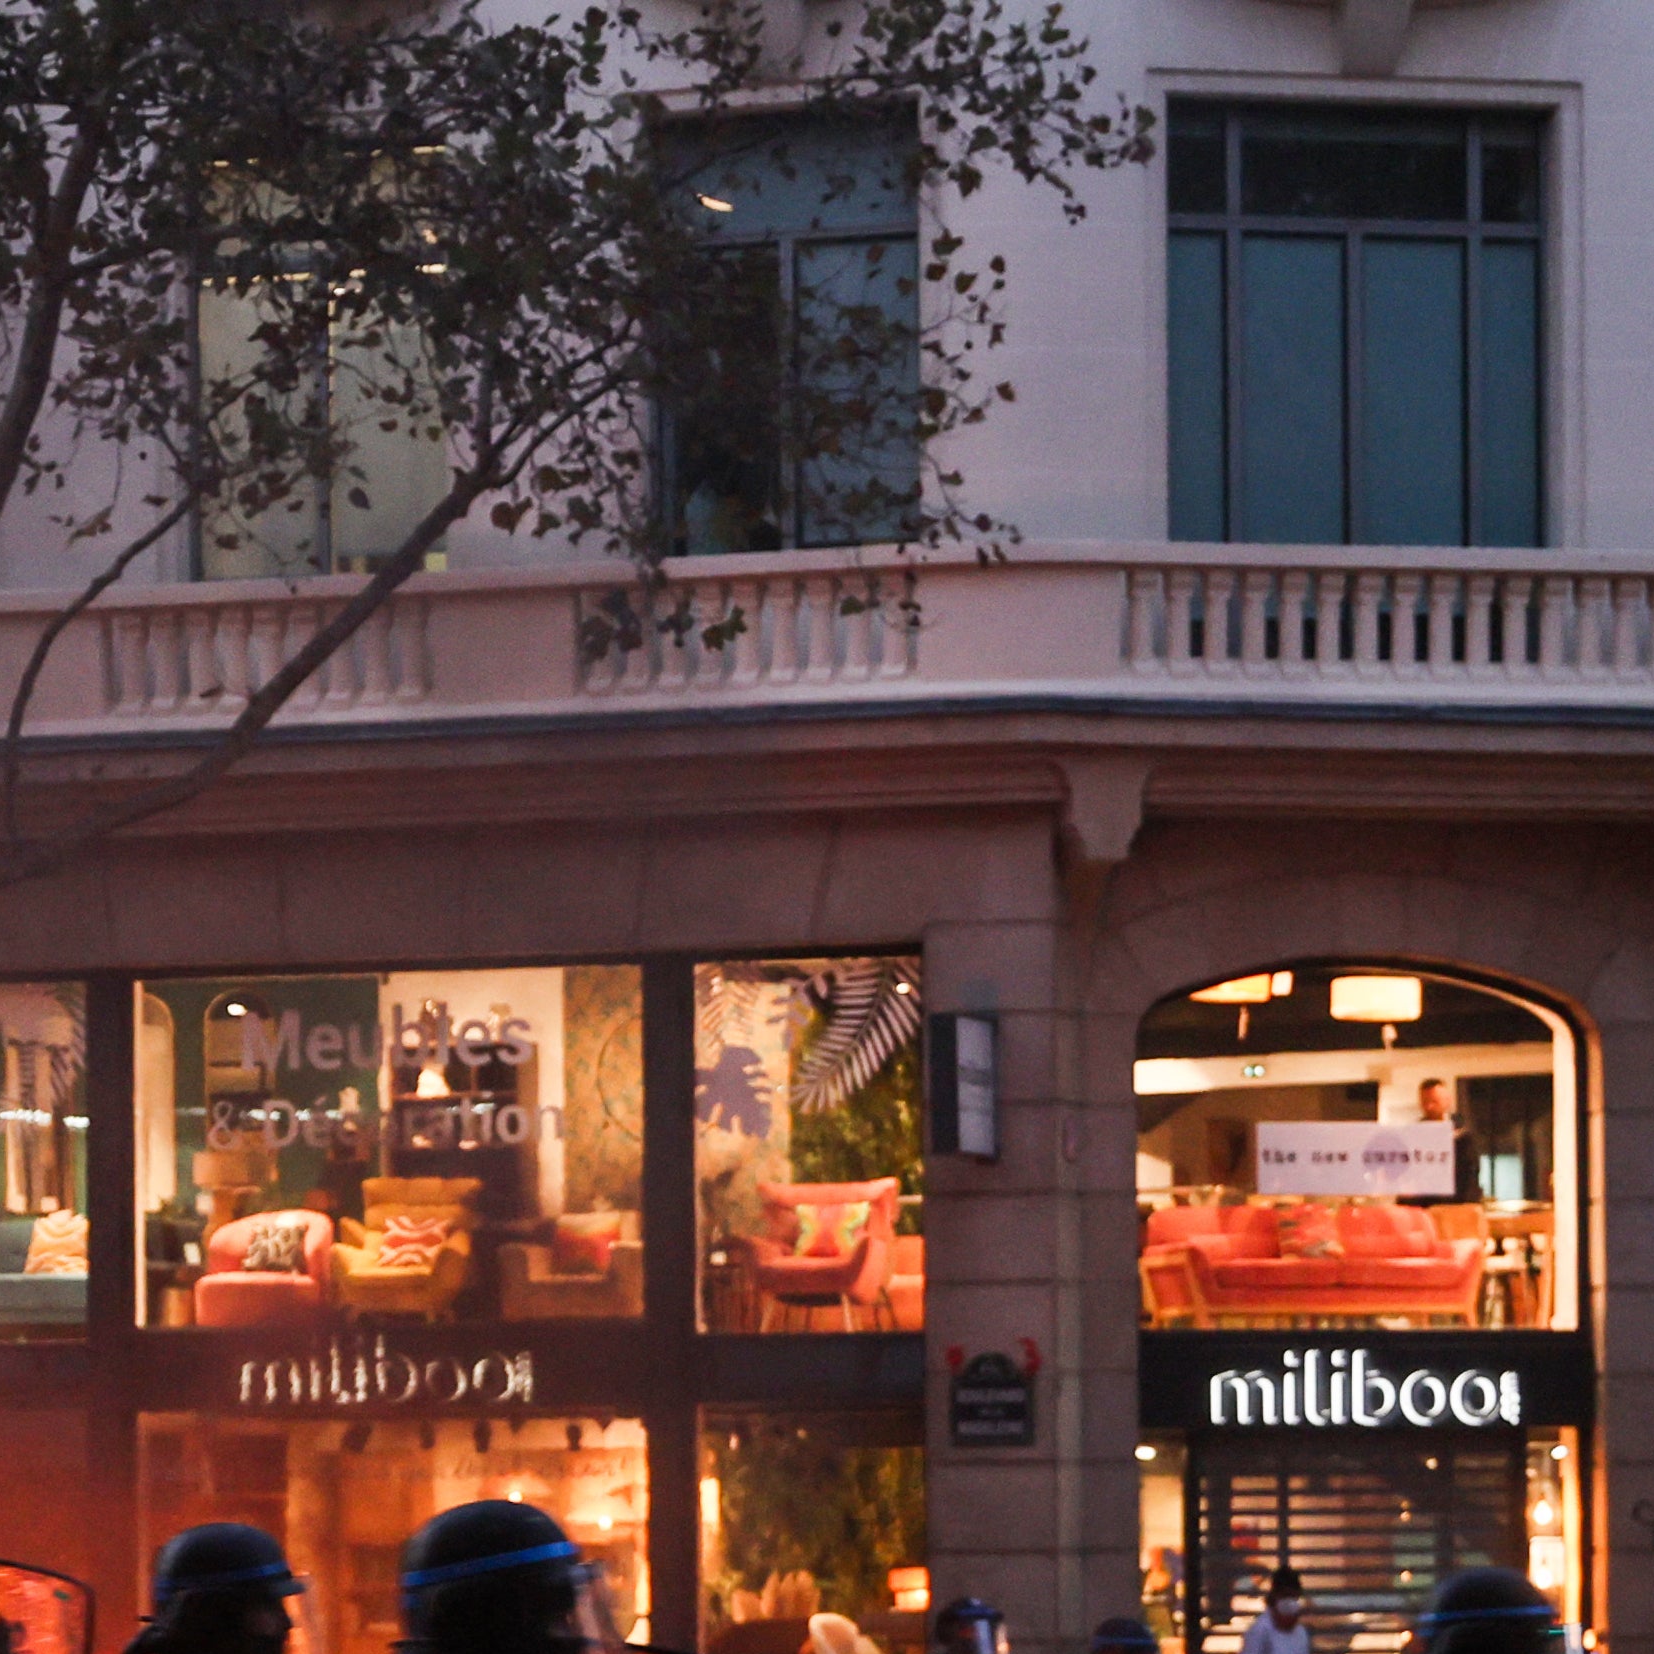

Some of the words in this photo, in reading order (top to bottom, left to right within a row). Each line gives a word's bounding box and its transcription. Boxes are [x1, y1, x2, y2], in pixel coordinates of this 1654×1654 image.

[241, 1002, 534, 1071] Meubles
[207, 1099, 242, 1150] &
[1263, 1149, 1296, 1164] the
